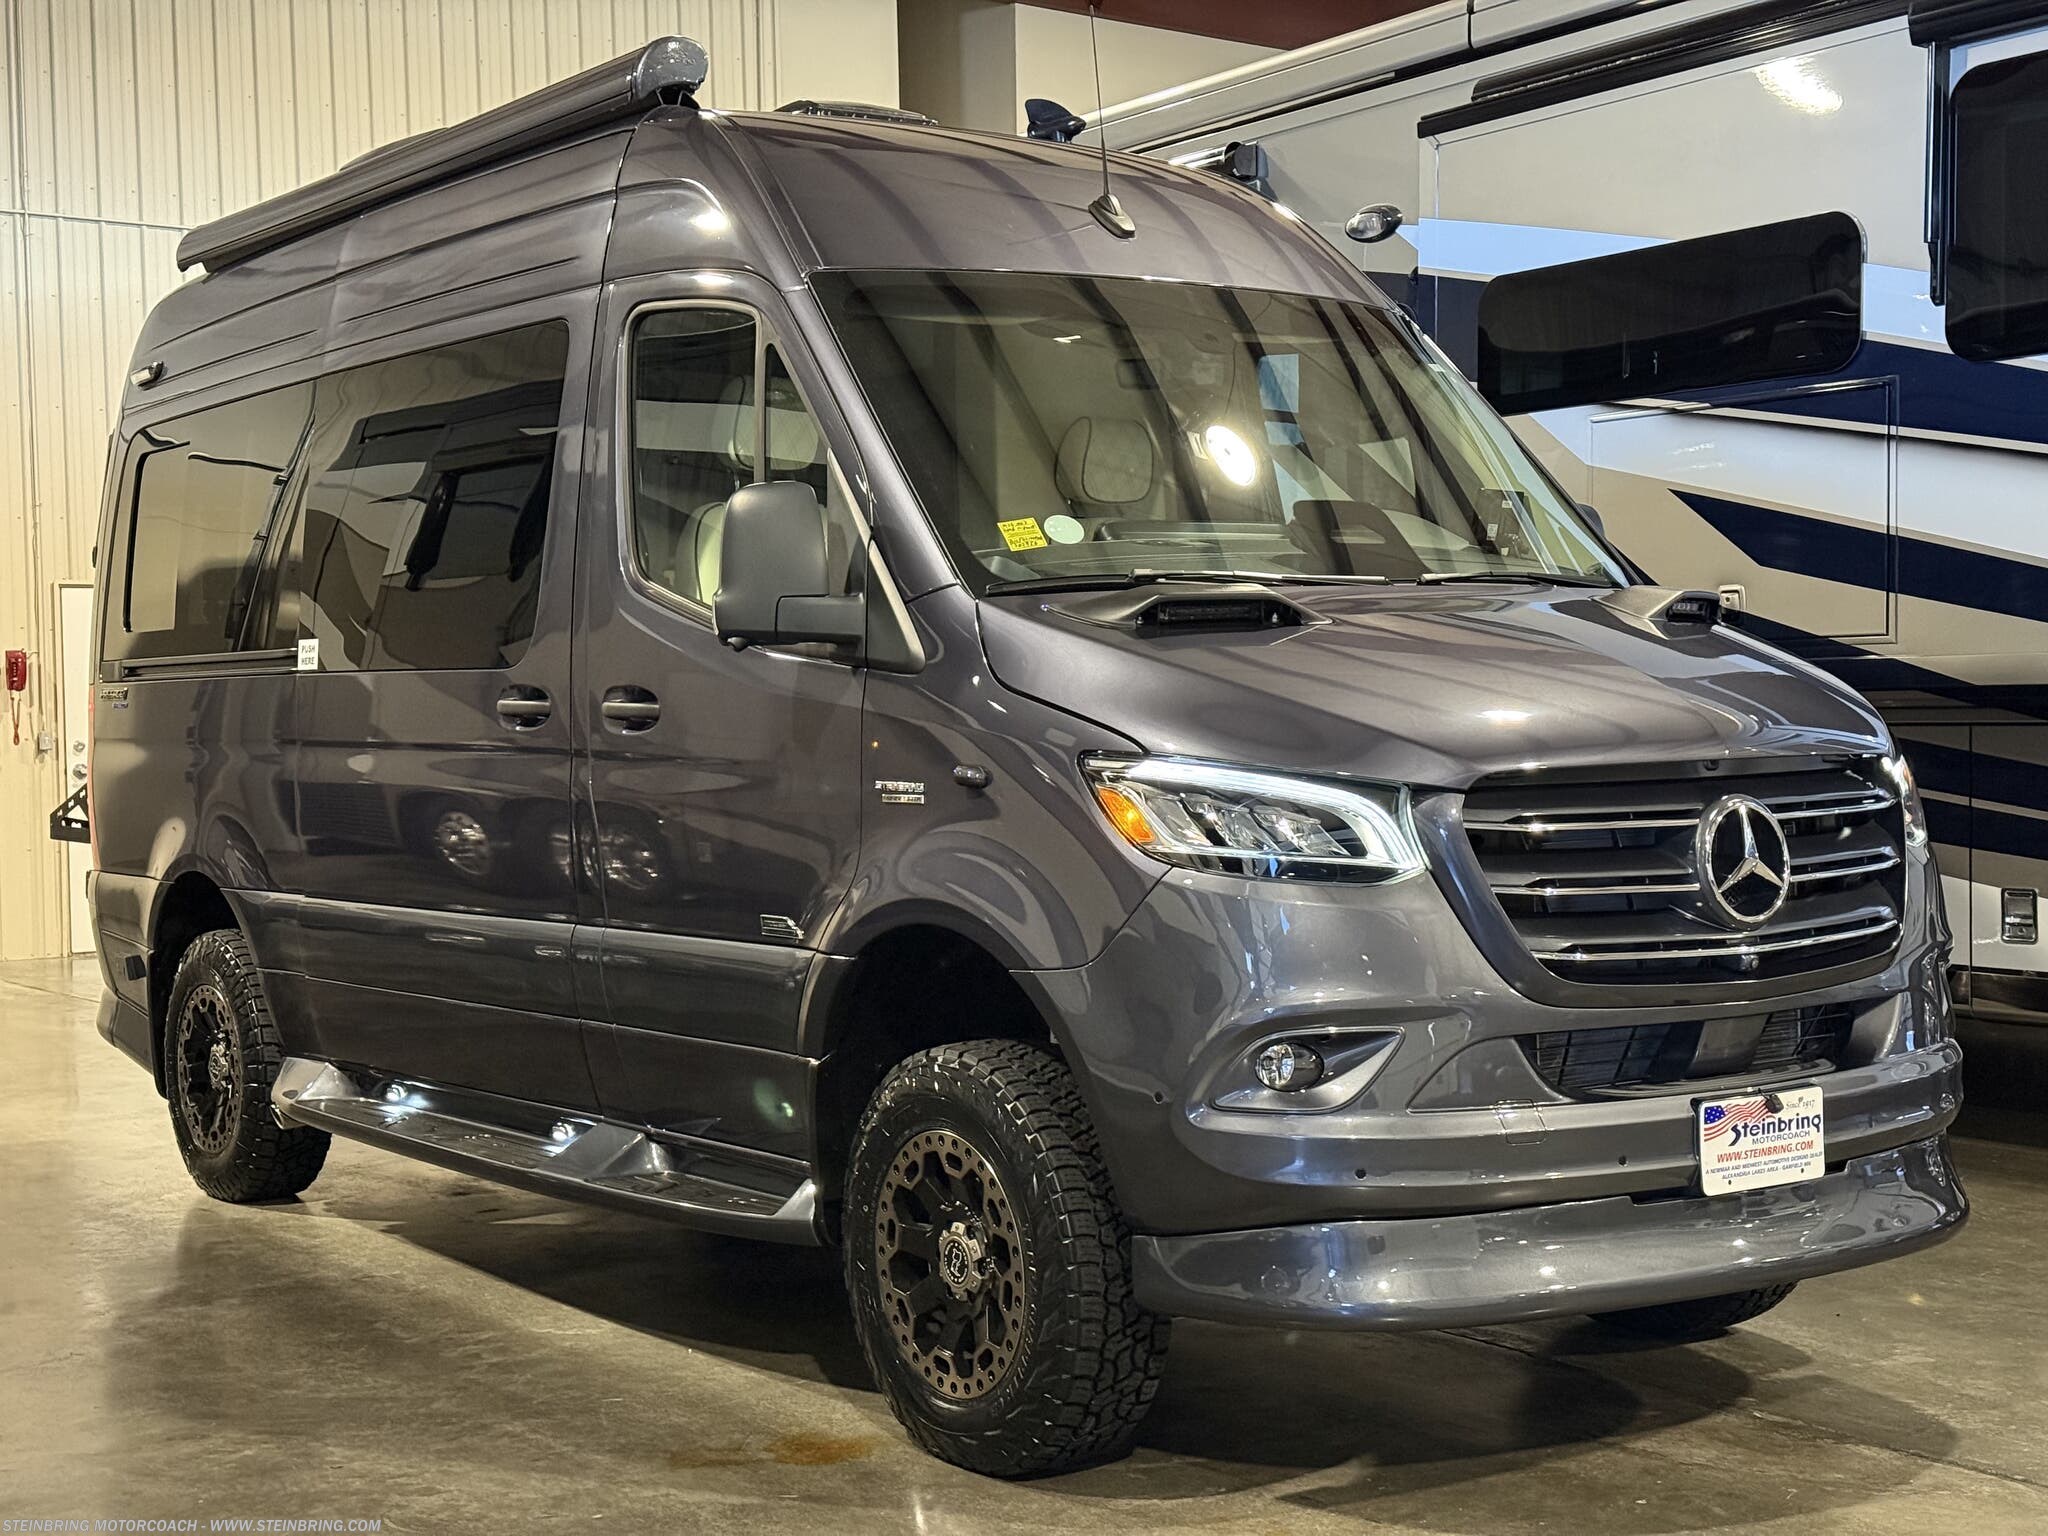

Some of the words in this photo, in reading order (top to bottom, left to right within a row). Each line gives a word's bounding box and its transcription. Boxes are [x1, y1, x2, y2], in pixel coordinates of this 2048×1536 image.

[1728, 1112, 1821, 1147] Steinbring
[1752, 1130, 1811, 1146] MOTORCOACH
[1716, 1140, 1814, 1164] WWW.STEINBRING.COM
[1731, 1163, 1742, 1171] AND
